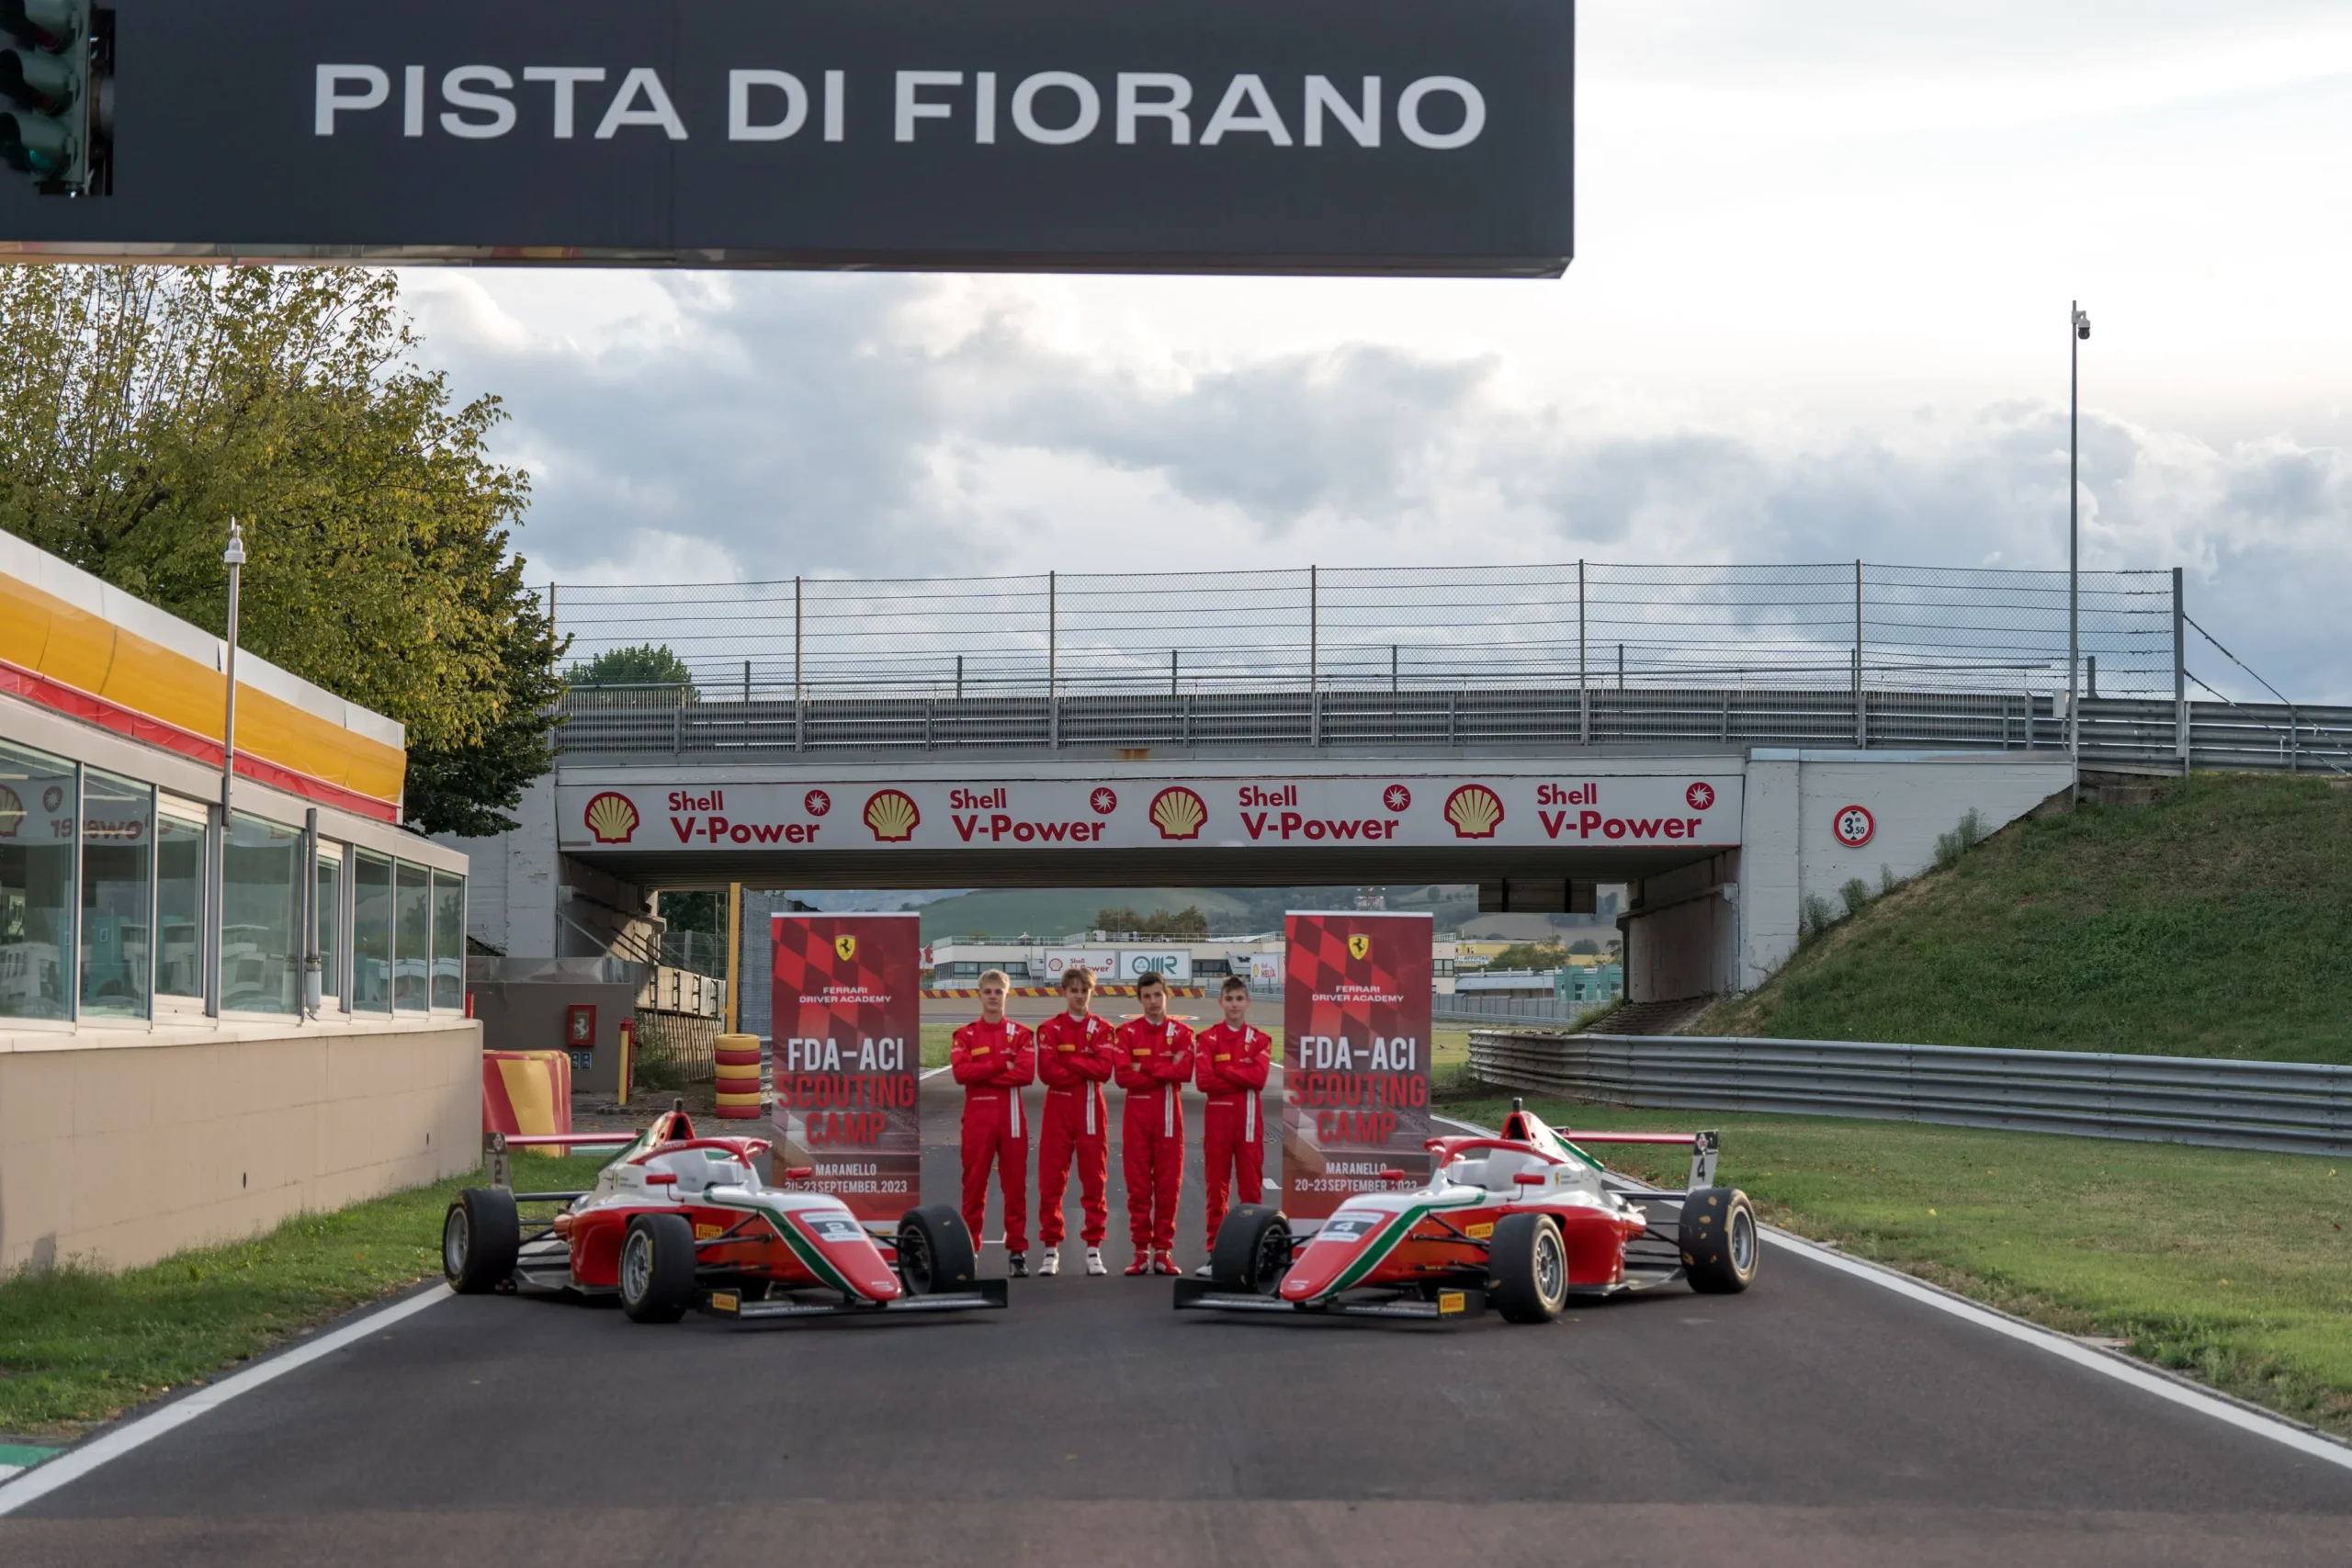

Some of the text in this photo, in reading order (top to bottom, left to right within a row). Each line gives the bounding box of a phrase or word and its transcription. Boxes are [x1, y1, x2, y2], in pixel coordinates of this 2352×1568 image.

[314, 63, 1487, 150] PISTA DI FIORANO
[668, 790, 724, 812] Shell
[950, 787, 1007, 810] Shell
[1238, 784, 1297, 807] Shell
[1536, 783, 1598, 805] Shell
[670, 816, 820, 843] V-Power
[951, 814, 1106, 841] V-Power
[1240, 812, 1399, 840] V-Power
[1537, 809, 1702, 839] V-Power
[798, 995, 892, 1004] DRIVER ACADEMY
[822, 986, 868, 995] FERRARI
[1311, 994, 1405, 1003] DRIVER ACADEMY
[1335, 985, 1381, 993] FERRARI
[787, 1036, 904, 1072] FDA-ACI
[1299, 1035, 1416, 1071] FDA-ACI
[776, 1073, 916, 1109] SCOUTING
[1288, 1072, 1427, 1109] SCOUTING
[805, 1111, 888, 1145] CAMP
[1316, 1109, 1396, 1145] CAMP
[815, 1163, 877, 1177] MARANELLO
[1697, 1156, 1706, 1182] 4
[817, 1180, 880, 1194] SEPTEMBER,
[881, 1180, 908, 1193] 2023
[1295, 1179, 1327, 1191] 20-23
[825, 1222, 849, 1232] 2
[1333, 1221, 1355, 1232] 4
